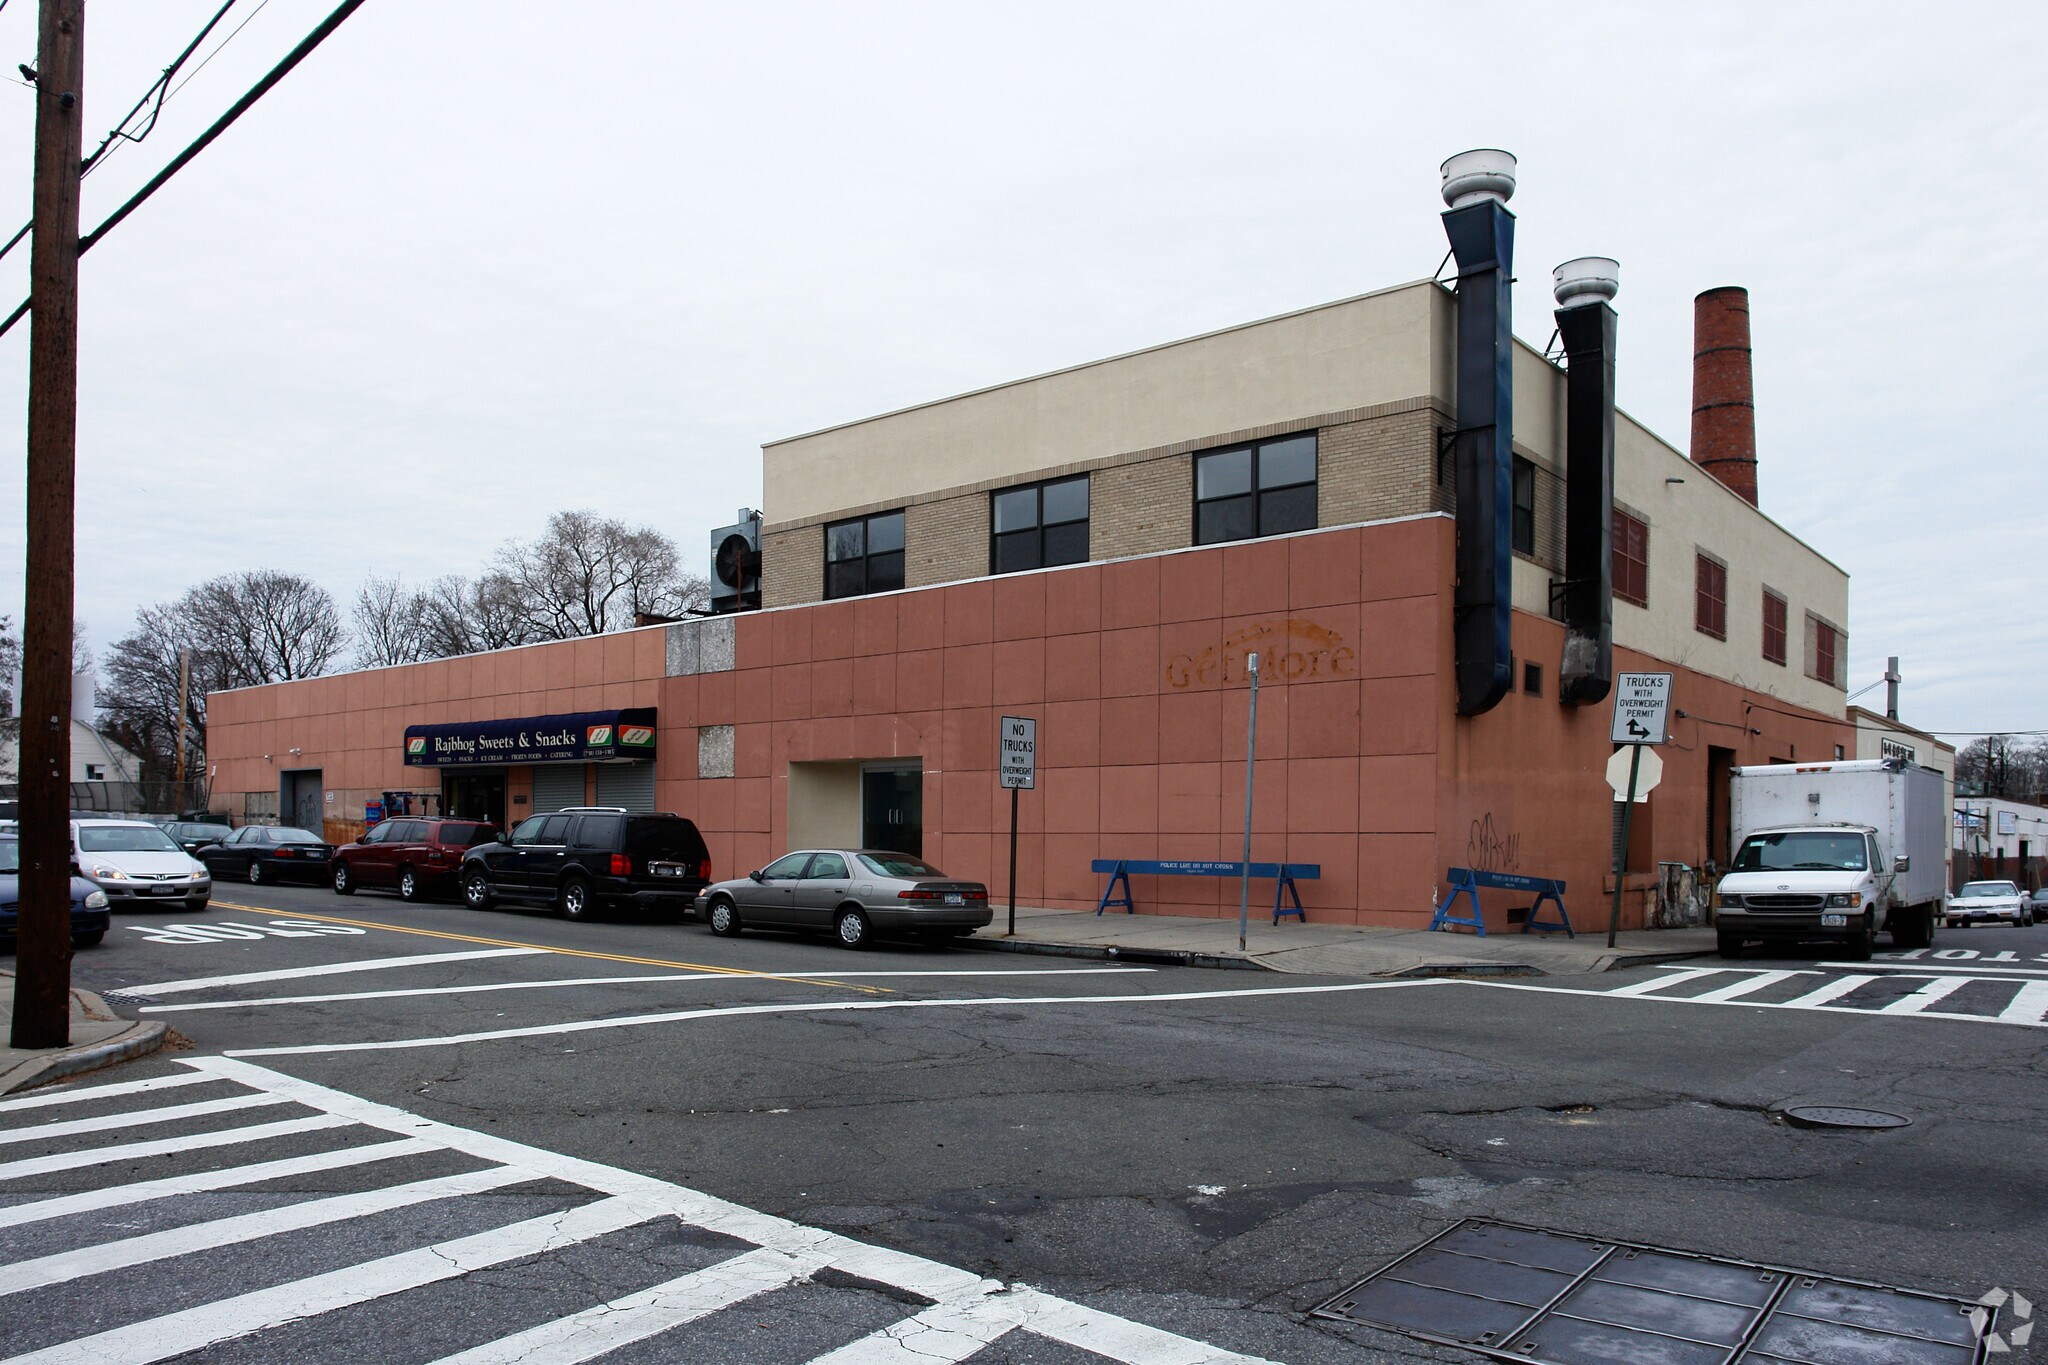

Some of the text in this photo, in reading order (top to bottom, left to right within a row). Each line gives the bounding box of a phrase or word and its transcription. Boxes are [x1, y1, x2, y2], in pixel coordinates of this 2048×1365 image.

[1626, 677, 1664, 687] TRUCKS
[1620, 699, 1664, 708] OVERWEIGHT
[1626, 709, 1655, 718] PERMIT
[1012, 724, 1025, 736] NO
[435, 736, 475, 754] Rajbhog
[479, 735, 514, 750] Sweets
[518, 732, 531, 748] &
[535, 729, 576, 747] Snacks
[1003, 739, 1033, 753] TRUCKS
[1011, 756, 1025, 764] WITH
[1002, 766, 1032, 776] OVERWEIGHT
[1007, 777, 1027, 785] PERMIT
[125, 920, 367, 945] STOP
